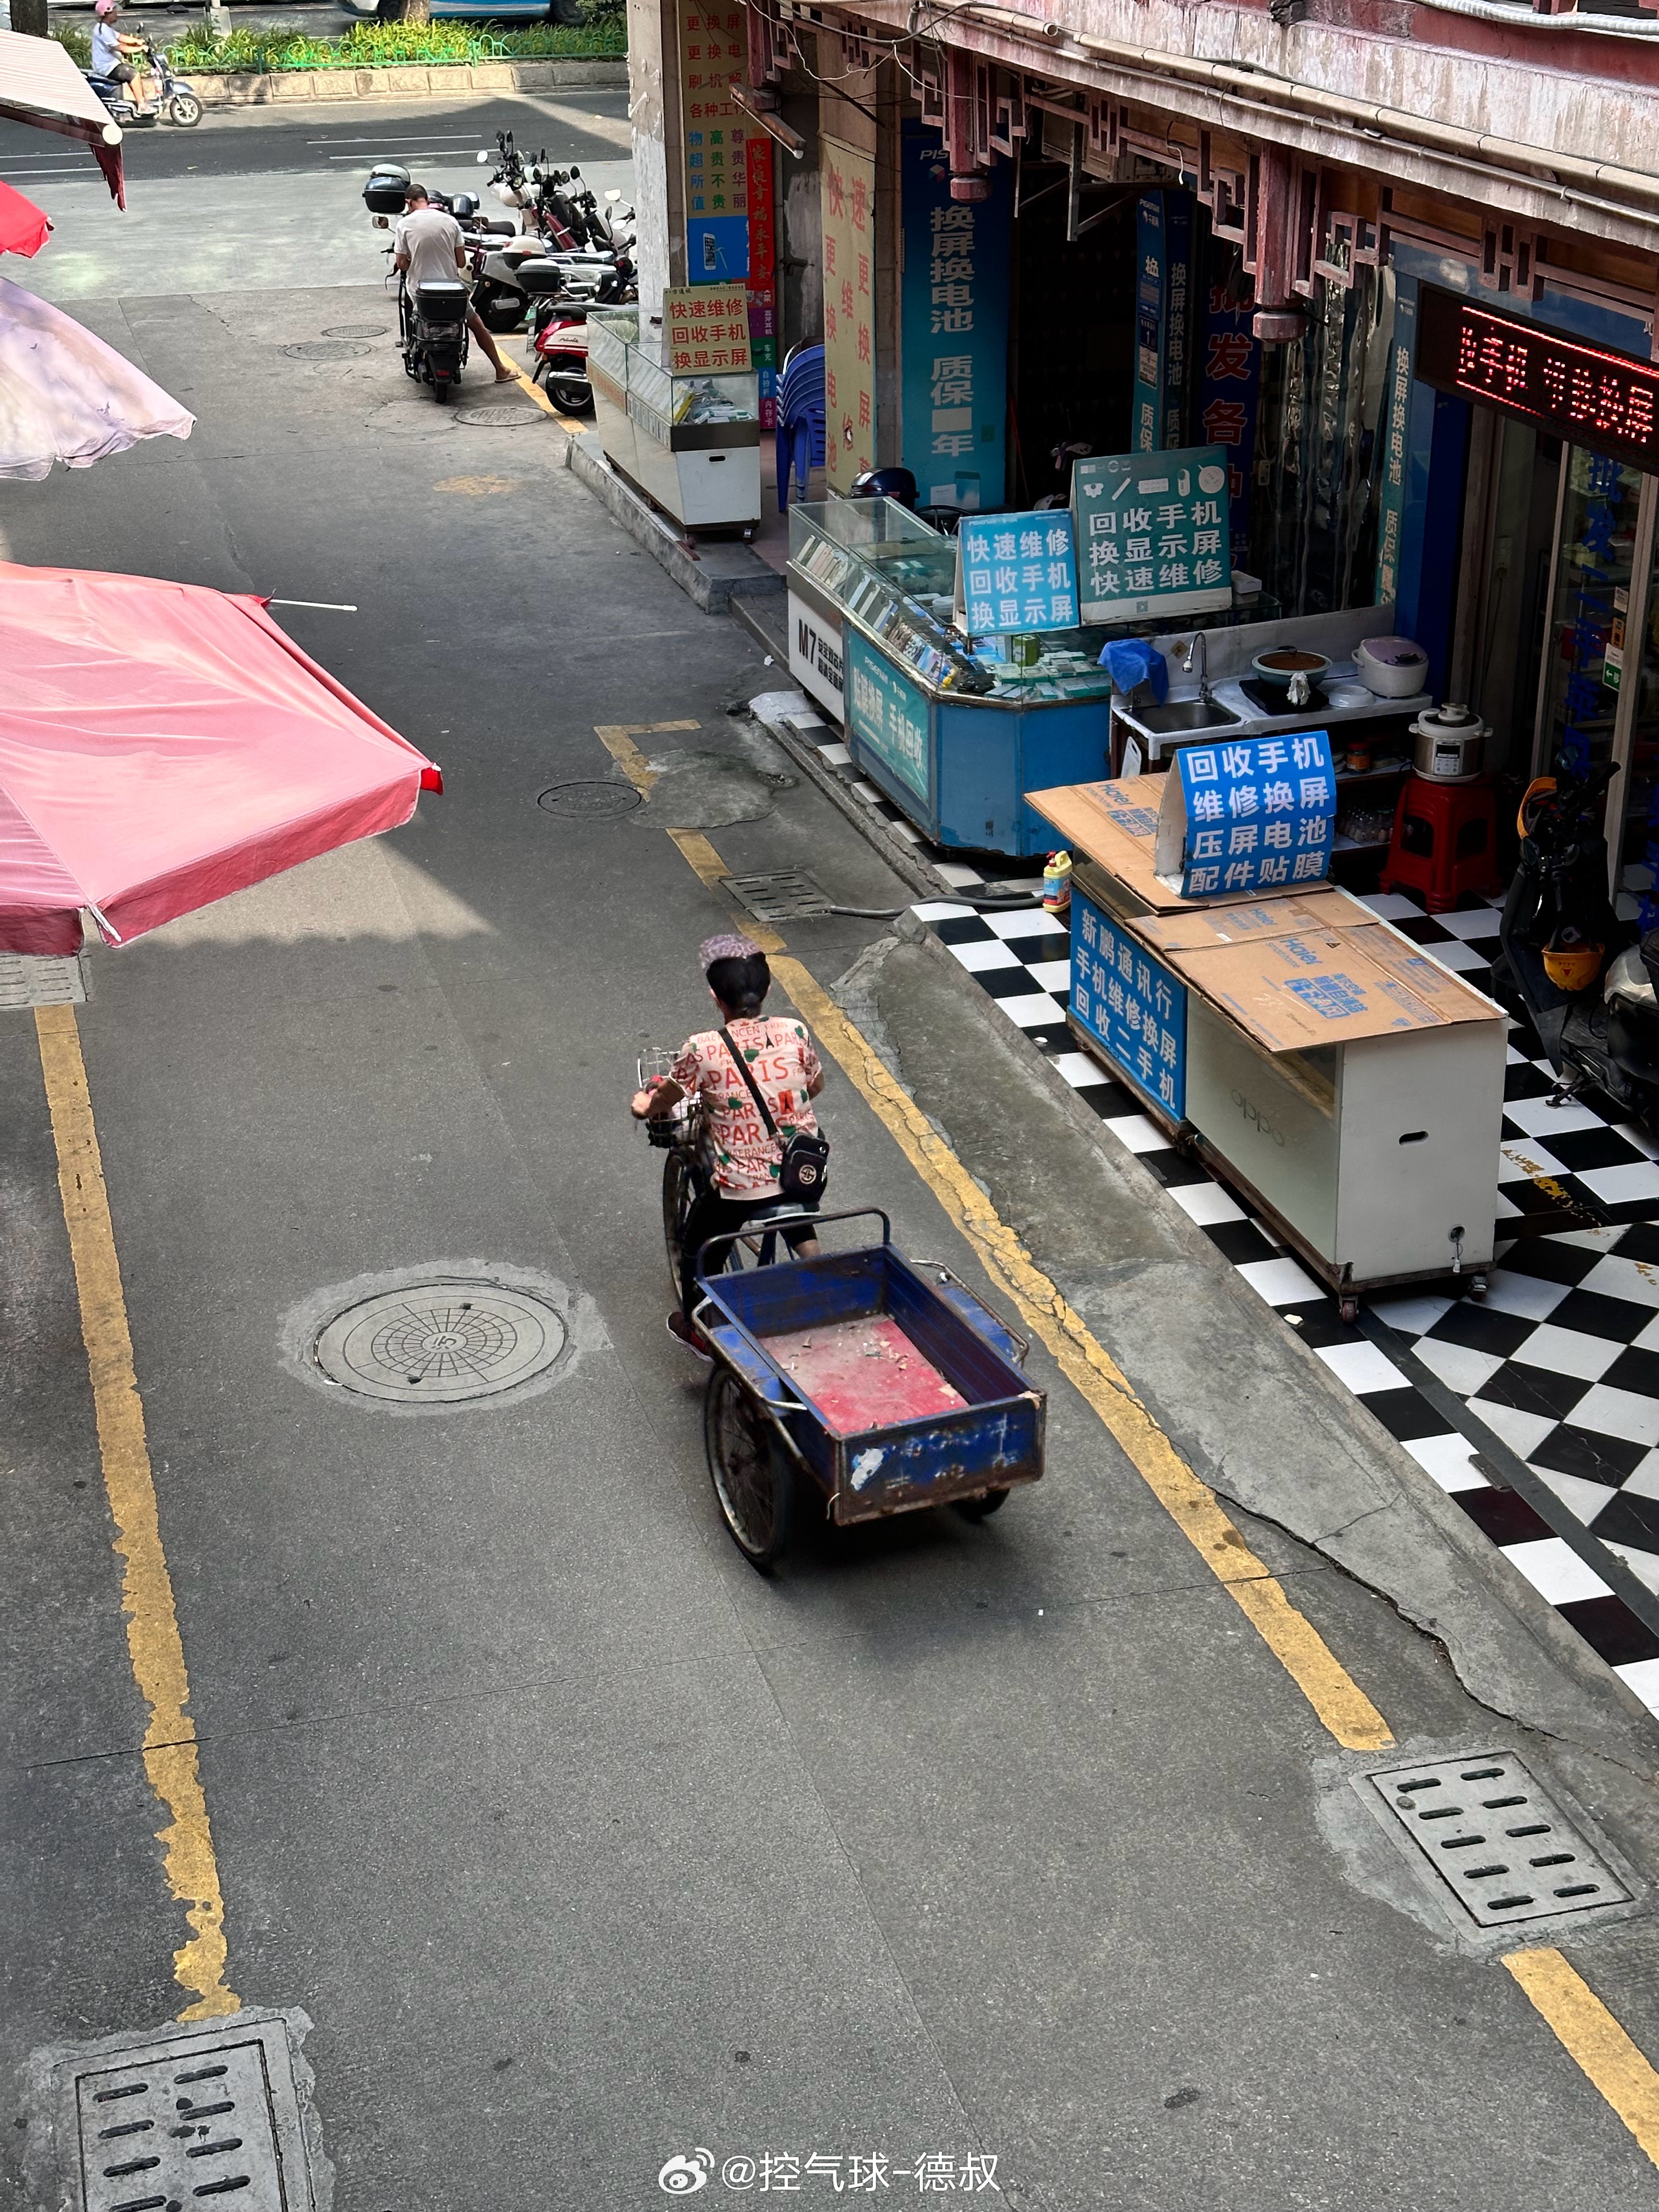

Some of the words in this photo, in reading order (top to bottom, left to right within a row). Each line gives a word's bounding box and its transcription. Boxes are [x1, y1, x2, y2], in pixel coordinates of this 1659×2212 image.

[689, 131, 705, 211] 物超所值
[710, 129, 725, 210] 高贵不贵
[730, 128, 747, 208] 尊贵华丽
[930, 205, 975, 334] 换屏换电池
[670, 298, 743, 320] 快速维修
[1167, 262, 1186, 387] 换屏换电池
[672, 324, 746, 345] 回收手机
[674, 348, 748, 369] 换显示屏
[930, 354, 975, 456] 质保年
[1389, 346, 1409, 486] 换屏换电池
[1090, 501, 1222, 536] 回收手机
[967, 528, 1069, 563] 快速维修
[1090, 531, 1222, 567] 换显示屏
[969, 562, 1071, 596] 回收手机
[1090, 558, 1223, 596] 快速维修
[972, 595, 1074, 630] 换显示屏
[799, 619, 817, 665] M7
[1186, 737, 1324, 783] 回收手机
[1097, 783, 1135, 805] Haier
[1193, 776, 1330, 822] 维修换屏
[1193, 815, 1327, 860] 压屏电池
[1188, 851, 1325, 893] 配件贴膜
[1082, 908, 1172, 1020] 新鹏通讯行
[1279, 938, 1323, 964] Haier
[1075, 945, 1176, 1069] 手机维修换屏
[1076, 983, 1175, 1110] 回收二手机
[721, 1097, 778, 1121] PARS
[1231, 1089, 1285, 1147] oppo
